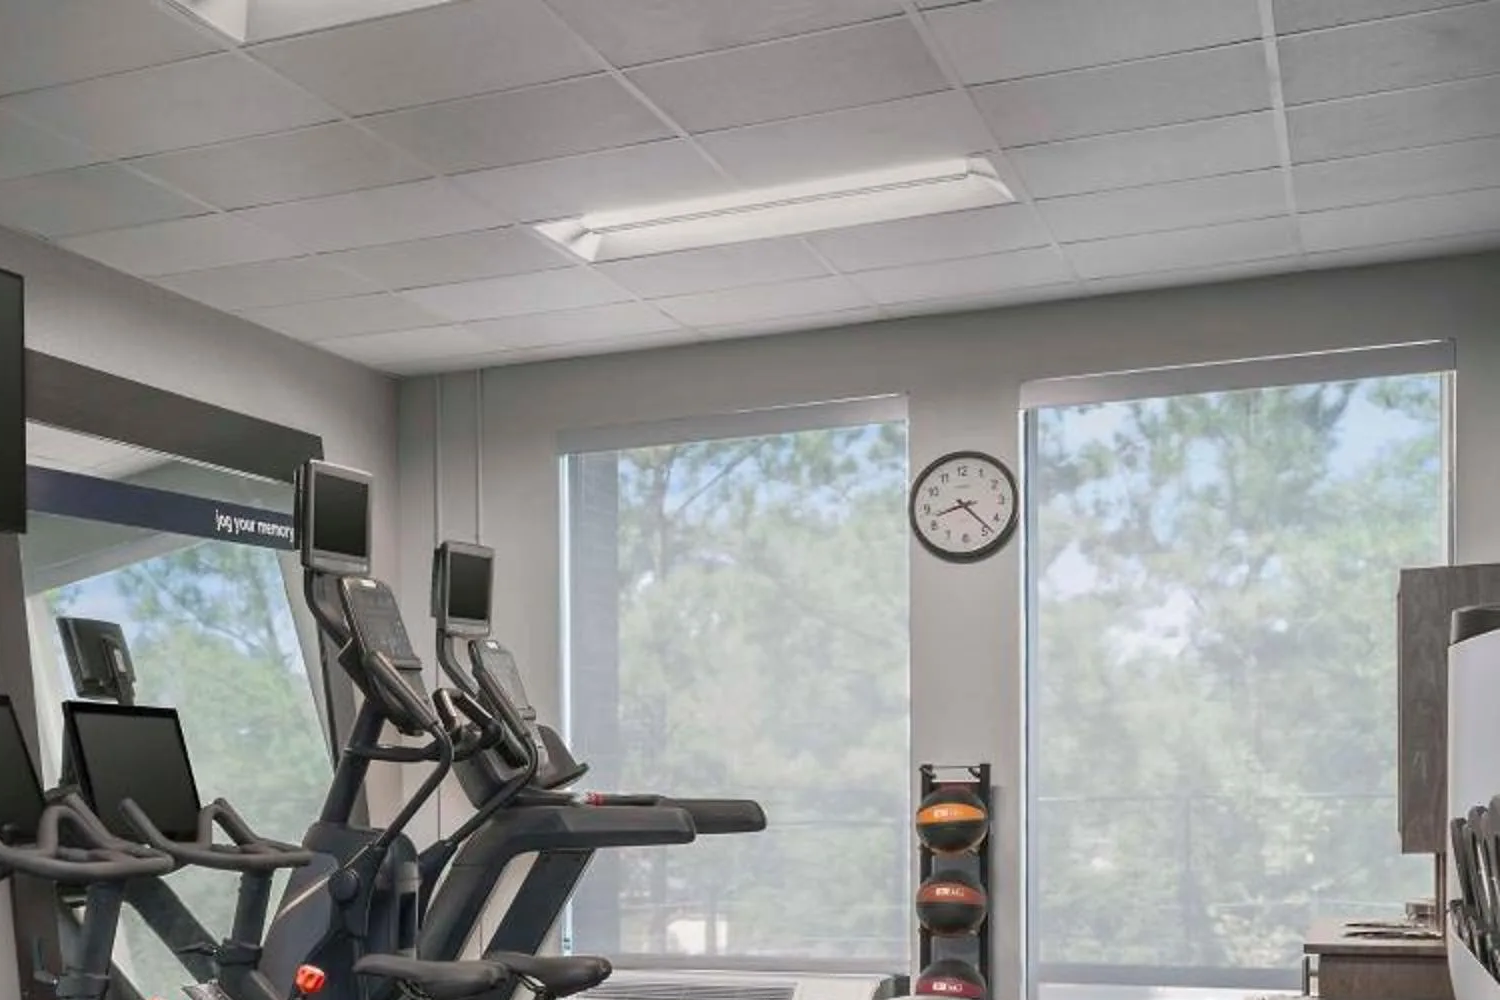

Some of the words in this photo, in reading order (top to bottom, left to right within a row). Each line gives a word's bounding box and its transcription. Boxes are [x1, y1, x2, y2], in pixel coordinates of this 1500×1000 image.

[957, 465, 968, 477] 12
[215, 508, 233, 533] jog
[233, 516, 255, 535] your
